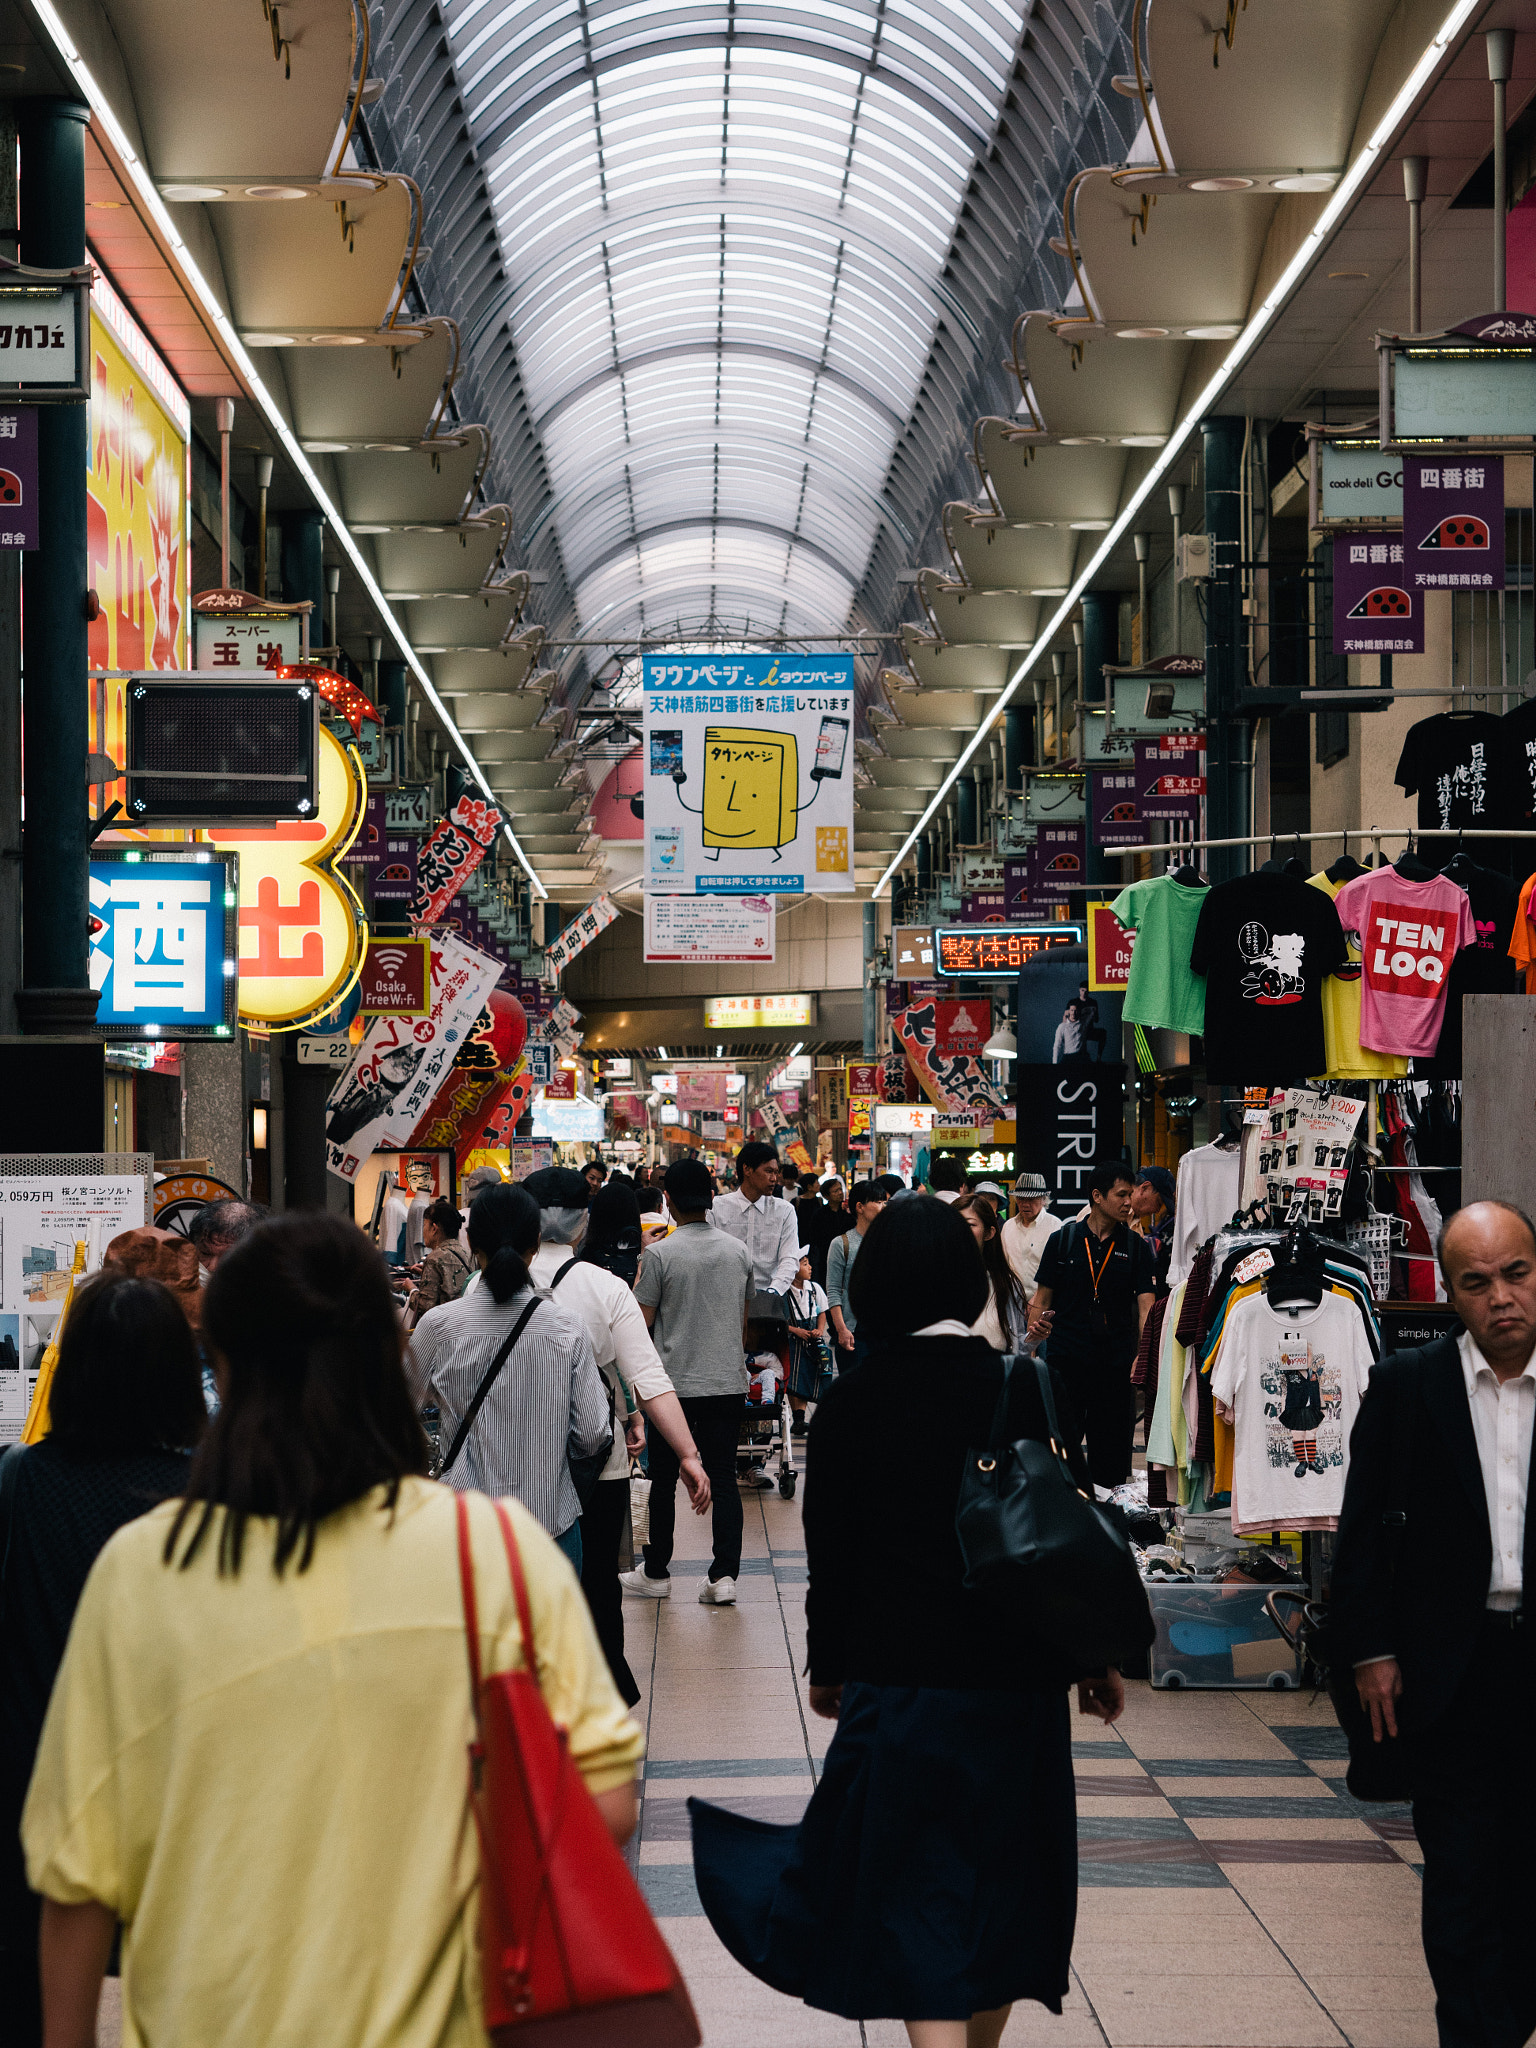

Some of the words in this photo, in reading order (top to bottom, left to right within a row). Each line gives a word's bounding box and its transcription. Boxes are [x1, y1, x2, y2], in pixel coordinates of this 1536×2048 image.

[1329, 476, 1352, 488] cook
[1353, 477, 1374, 488] deli
[1420, 467, 1485, 489] 四番街
[1415, 573, 1494, 585] 天神橋筋商店会
[226, 626, 270, 637] スーパー
[1343, 639, 1414, 650] 天神橋筋商店会
[650, 695, 850, 714] 天神橋筋四番街を応援しています
[711, 747, 773, 762] タウンページ
[1163, 778, 1201, 789] 送水口
[1452, 764, 1470, 799] 俺に
[1469, 742, 1487, 815] 日経平均は
[1045, 831, 1078, 842] 四番街
[700, 877, 799, 886] 自転車は押して歩きましょう
[1375, 917, 1446, 952] TEN
[1105, 964, 1131, 979] Free
[1373, 948, 1444, 985] LOQ
[375, 980, 407, 993] Osaka
[366, 993, 392, 1006] Free
[1330, 1098, 1356, 1114] ¥200
[939, 1130, 970, 1141] 営業中
[1056, 1079, 1098, 1226] STRE
[967, 1151, 1014, 1173] 全身
[62, 1187, 133, 1196] 桜ノ宮コンソルト
[1398, 1327, 1430, 1340] simple
